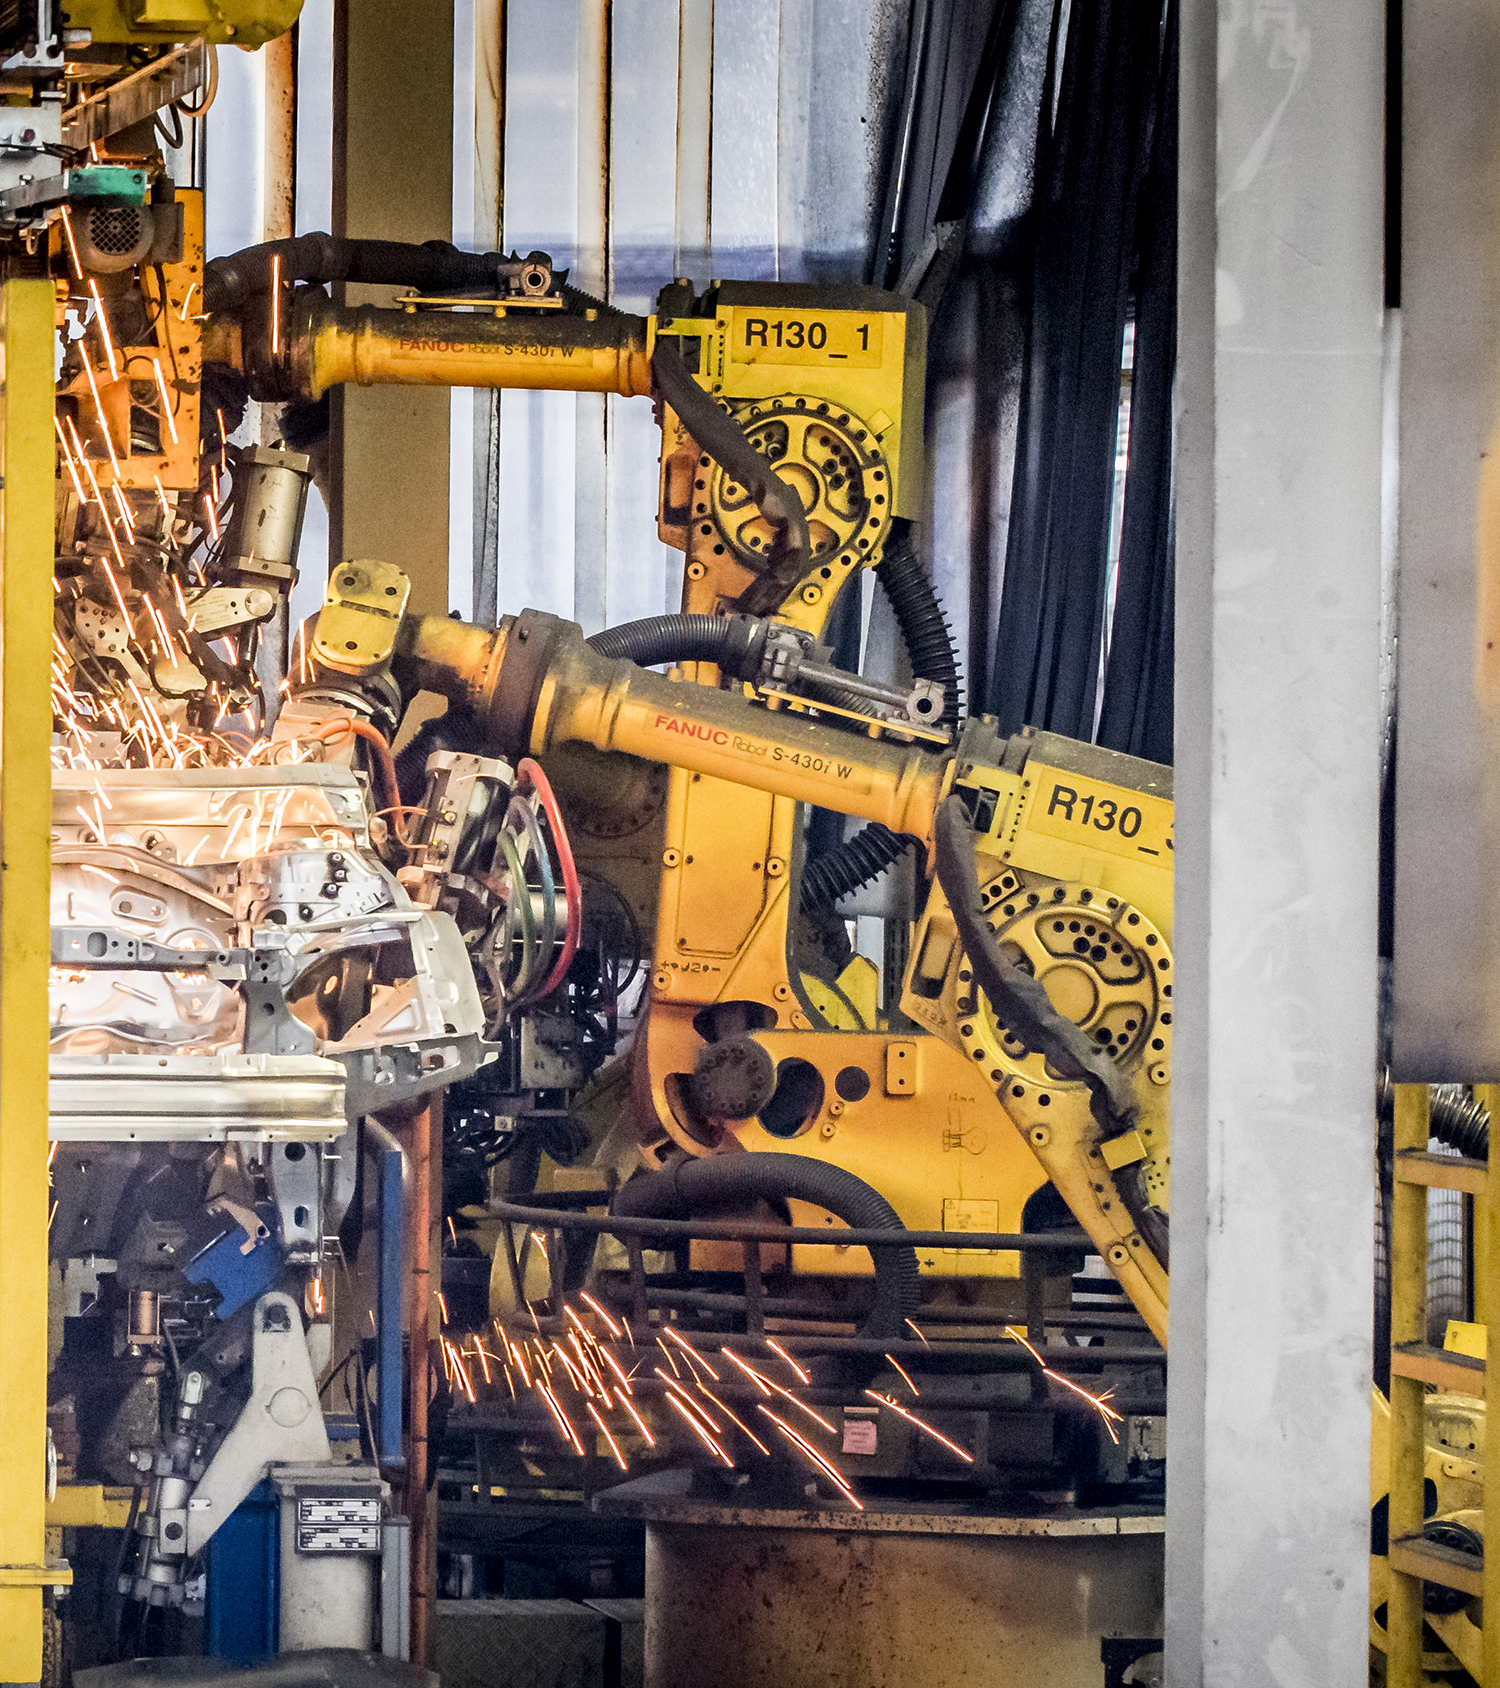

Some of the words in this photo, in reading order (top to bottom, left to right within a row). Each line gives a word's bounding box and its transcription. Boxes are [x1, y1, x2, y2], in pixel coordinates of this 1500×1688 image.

[399, 339, 464, 354] FANUC
[561, 346, 576, 358] W
[654, 714, 729, 746] FANUC
[731, 735, 769, 758] Robot
[771, 746, 833, 775] S-430i
[837, 763, 853, 779] W
